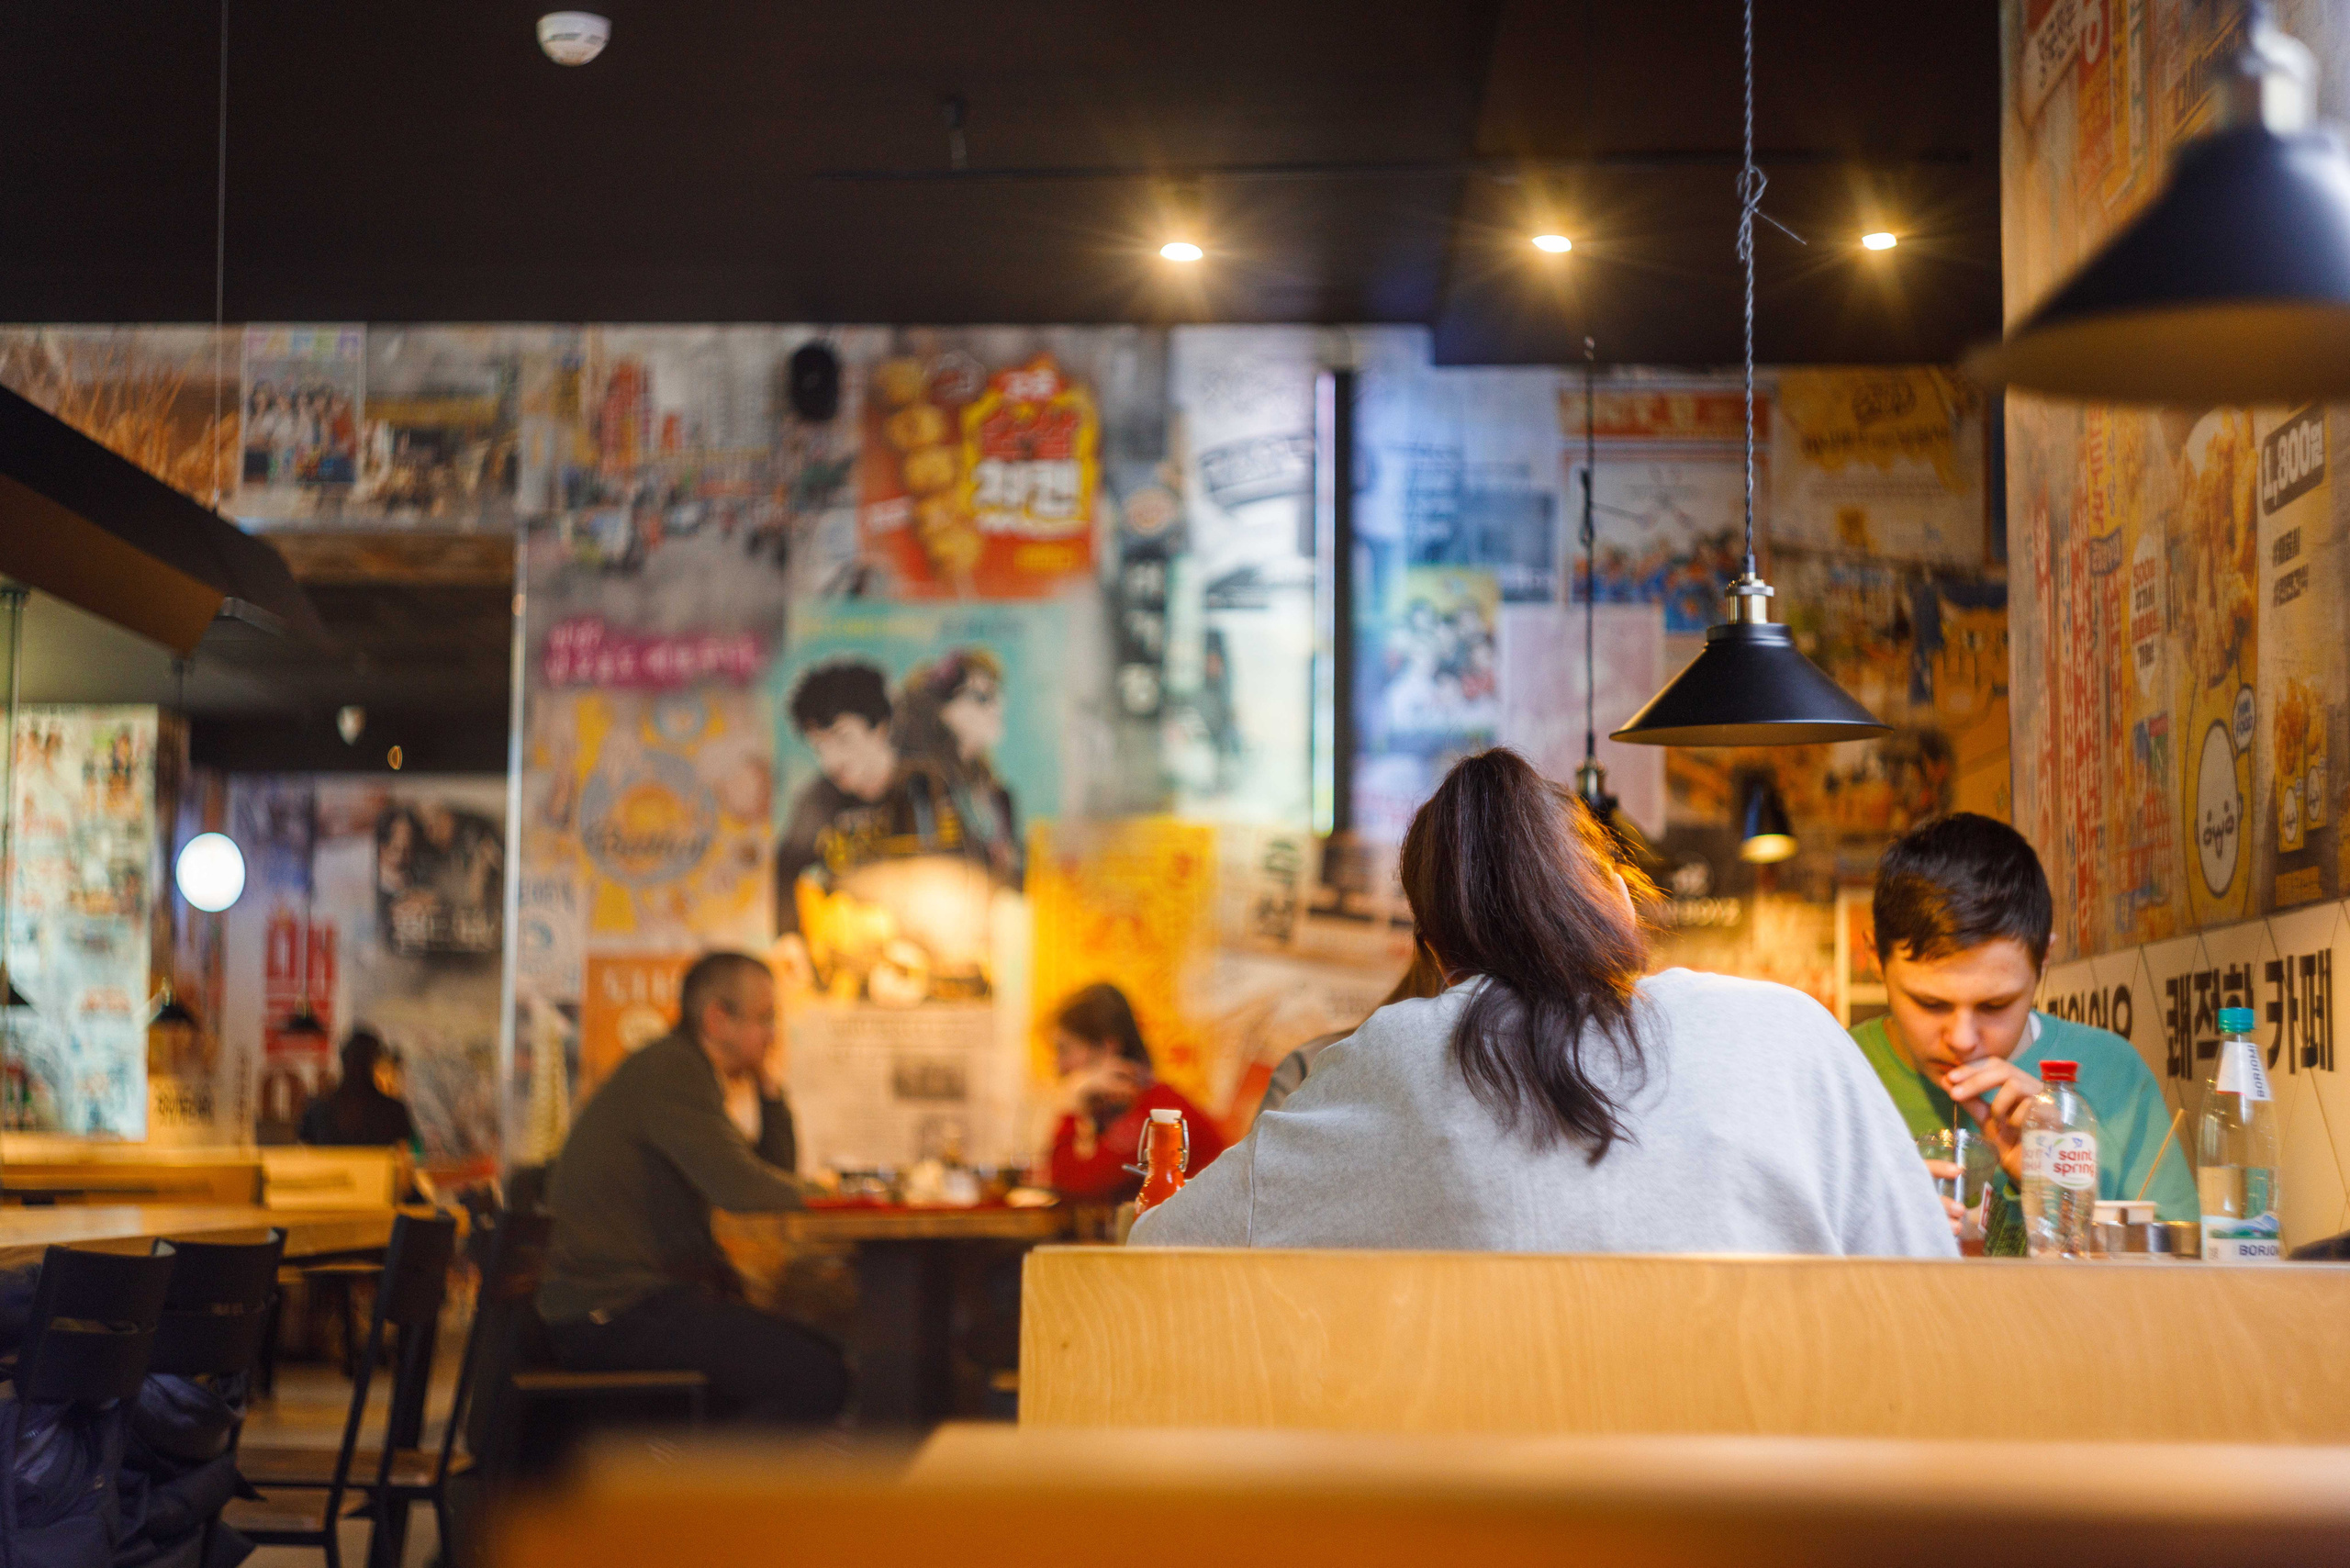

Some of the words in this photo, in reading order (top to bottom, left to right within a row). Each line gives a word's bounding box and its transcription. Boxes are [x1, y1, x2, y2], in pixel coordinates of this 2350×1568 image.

[2266, 947, 2334, 1075] 카페
[2058, 1149, 2094, 1161] saint
[2053, 1162, 2095, 1179] spring
